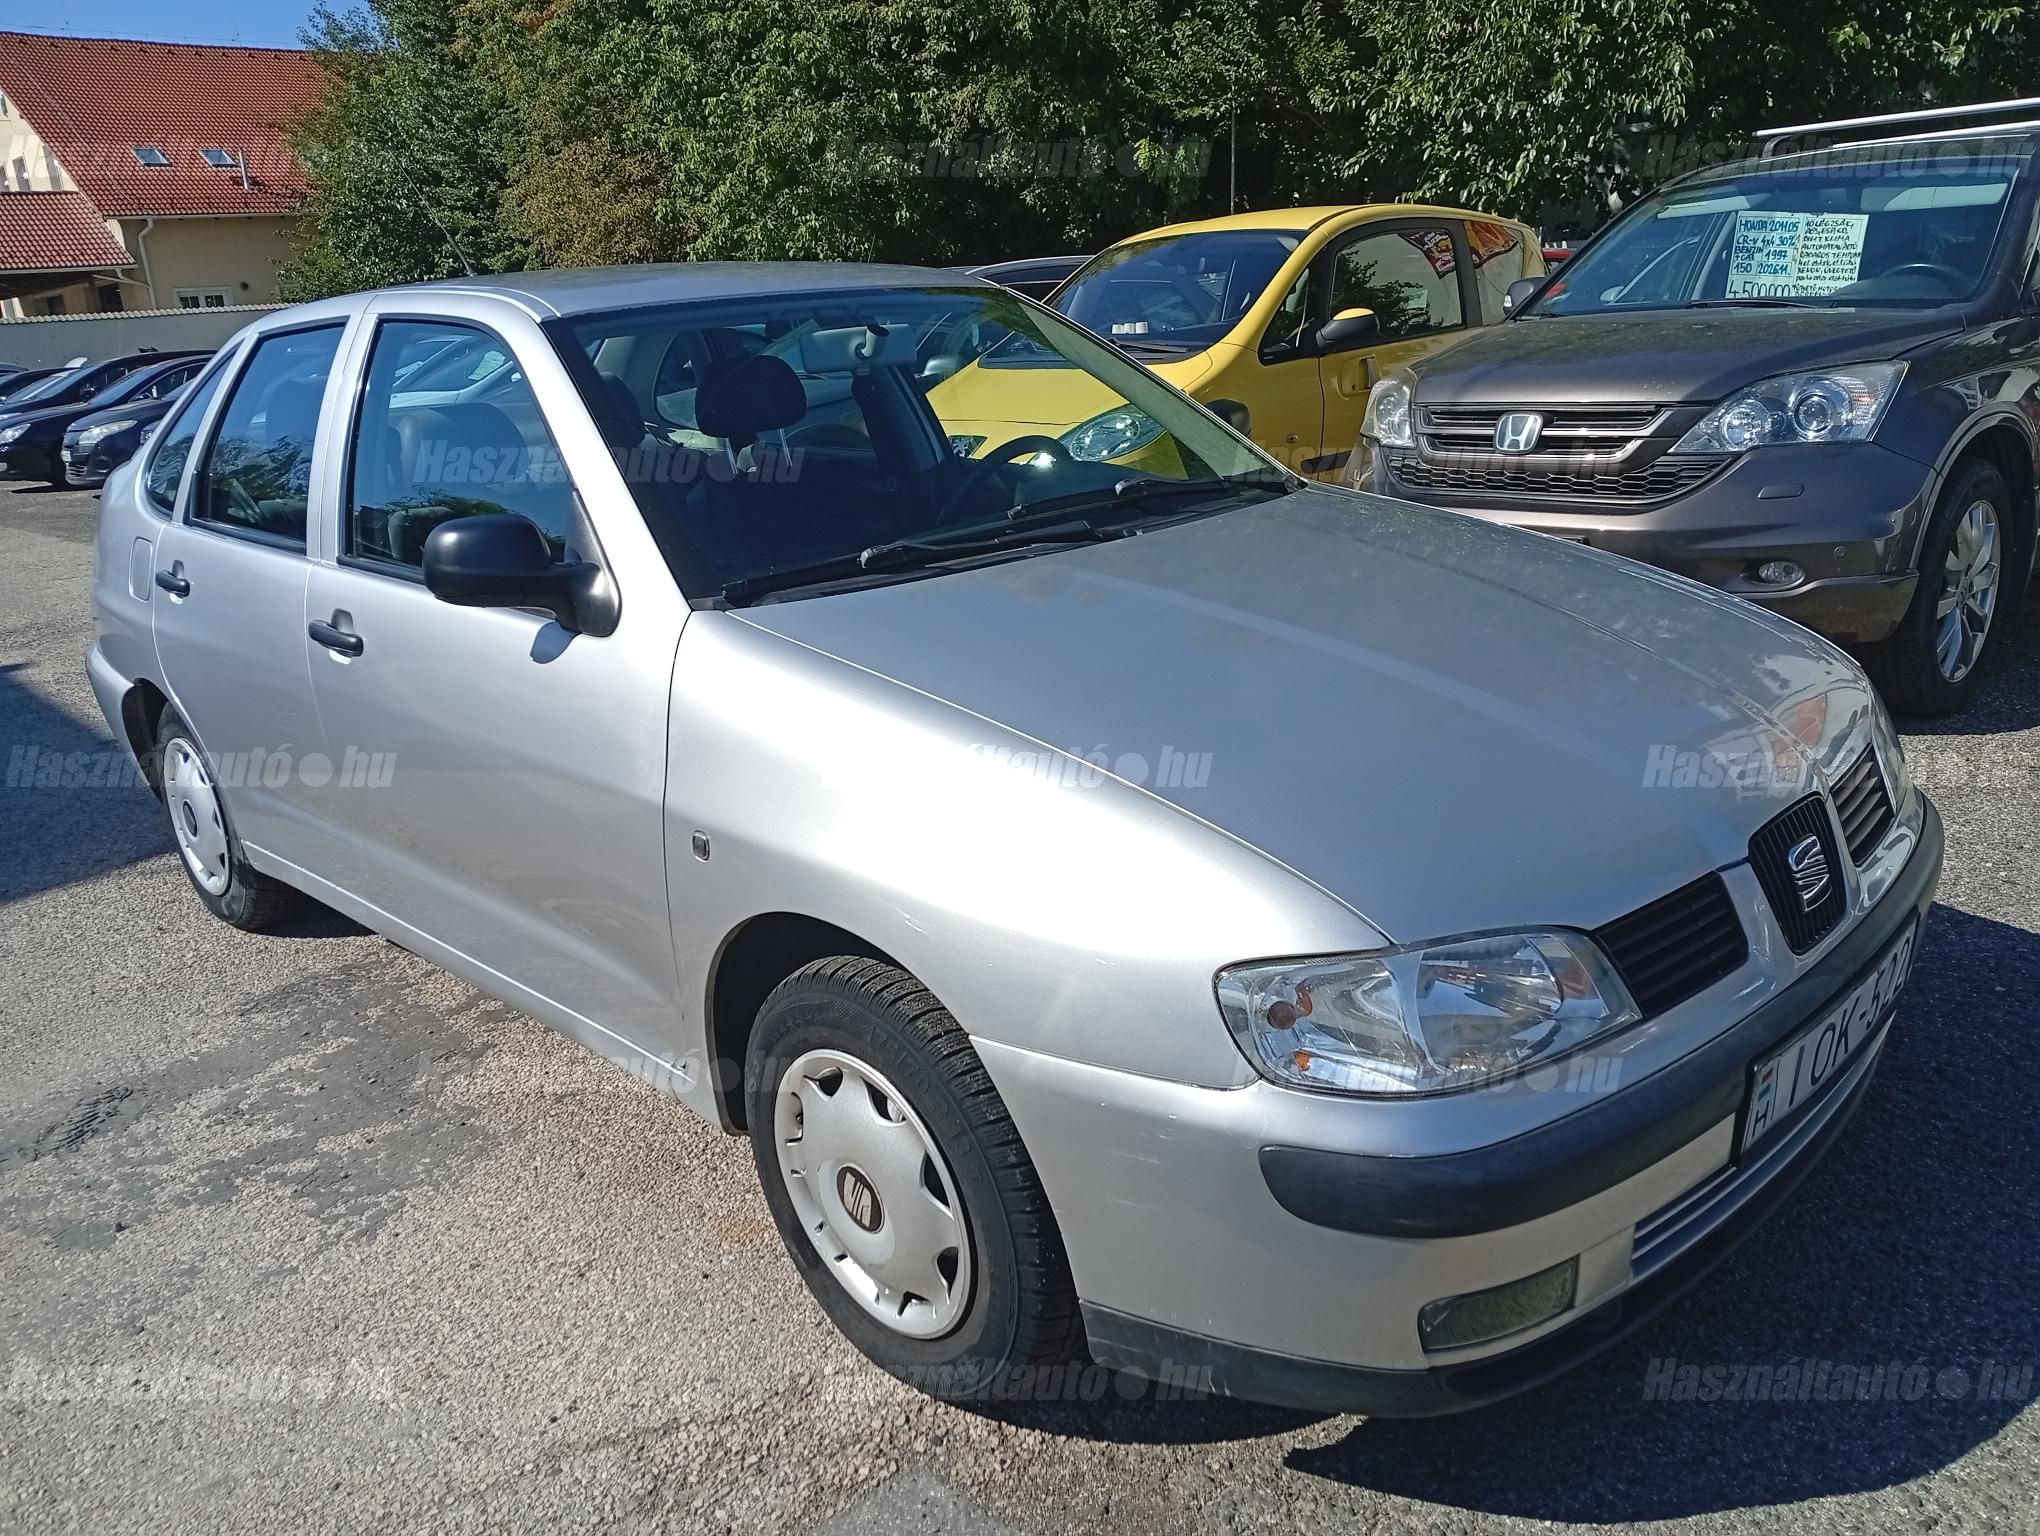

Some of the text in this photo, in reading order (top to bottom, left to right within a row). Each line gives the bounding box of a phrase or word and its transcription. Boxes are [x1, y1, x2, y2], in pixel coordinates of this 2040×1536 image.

[1739, 219, 1768, 232] HONDA
[1736, 234, 1759, 246] CR-V
[1734, 246, 1764, 254] BENZIN
[1764, 249, 1788, 261] 1997
[1733, 262, 1752, 273] 150
